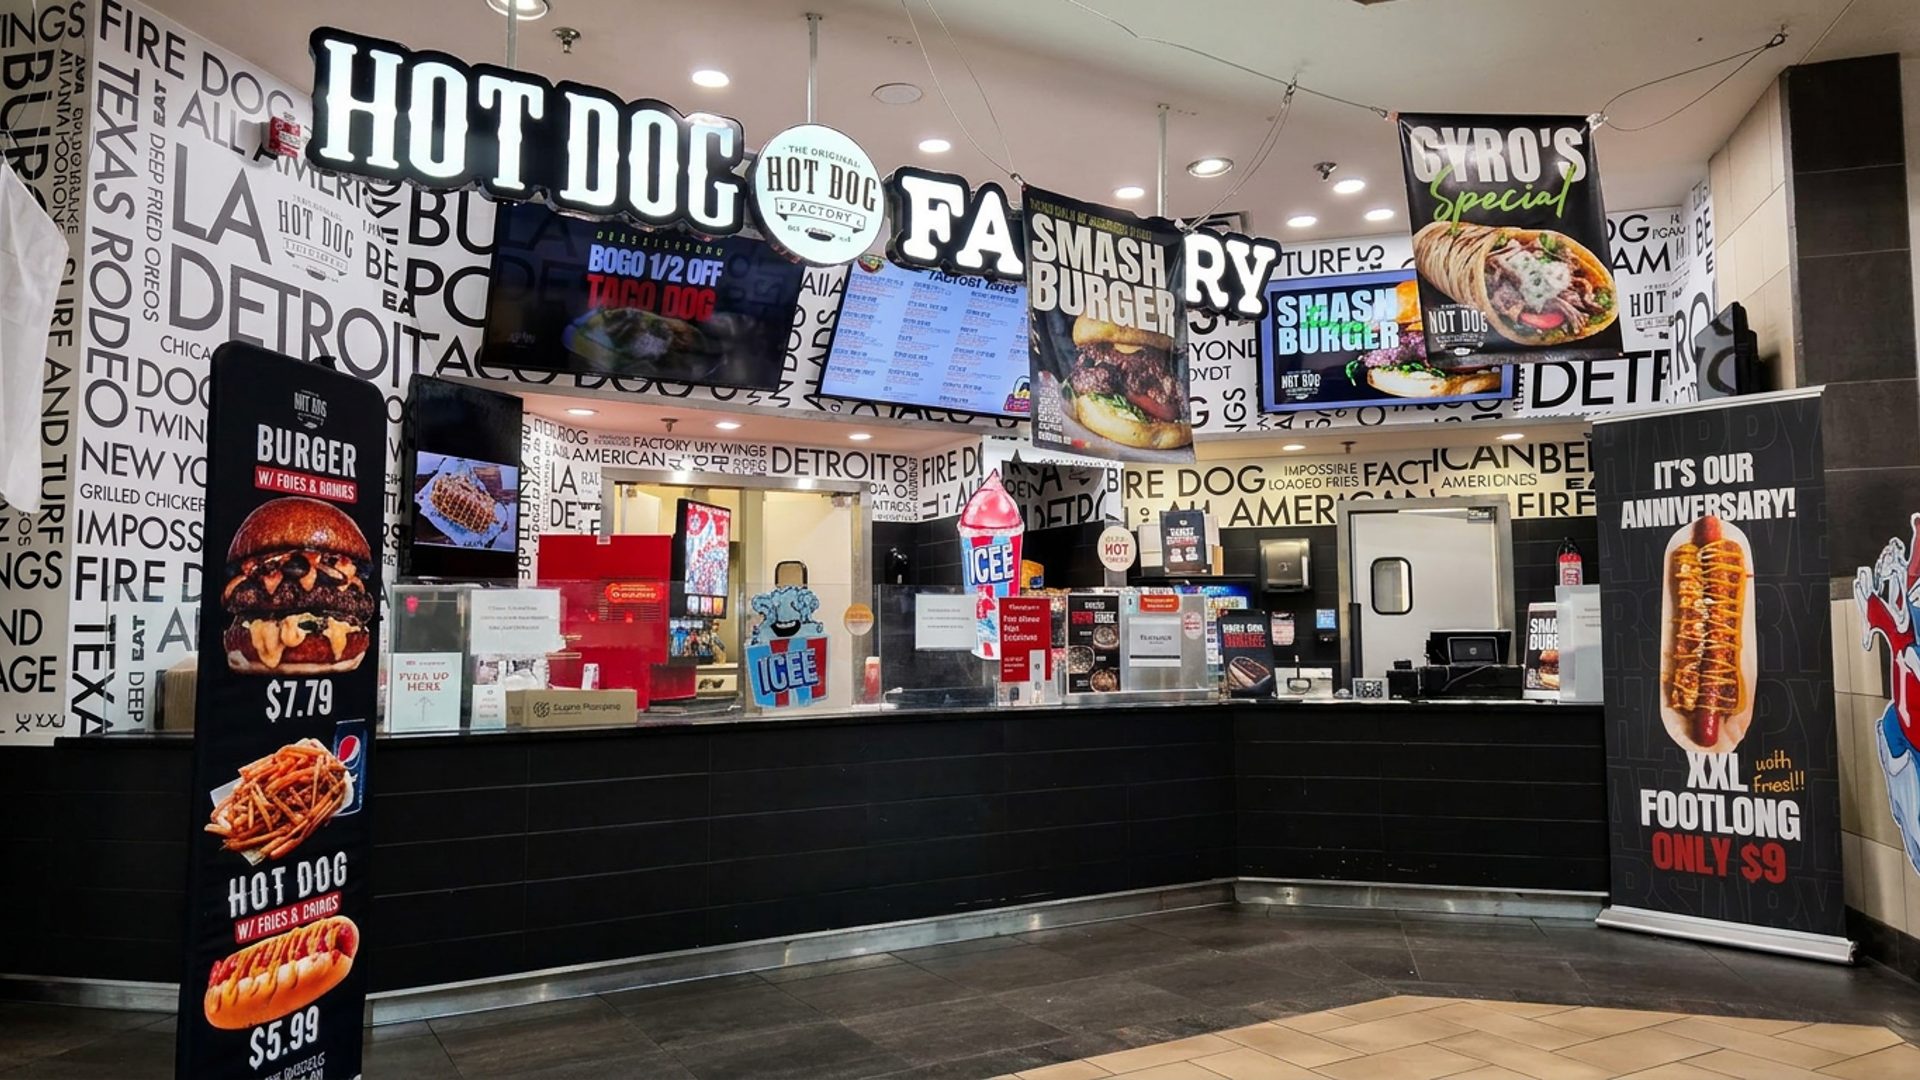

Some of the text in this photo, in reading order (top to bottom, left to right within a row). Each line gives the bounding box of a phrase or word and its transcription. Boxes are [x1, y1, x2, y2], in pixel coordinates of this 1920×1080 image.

[0, 1, 86, 48] INGS
[99, 1, 187, 80] FIRE
[1, 50, 54, 216] BUR
[177, 89, 245, 156] ALL
[320, 38, 544, 191] HOT
[559, 91, 739, 228] DOG
[149, 132, 166, 186] DEEP
[789, 145, 808, 155] THE
[1410, 126, 1587, 183] GYRO'S
[766, 156, 818, 194] HOT
[146, 187, 164, 242] FRIED
[172, 142, 272, 266] LA
[278, 199, 313, 240] HOT
[1430, 163, 1578, 235] Special
[85, 61, 141, 428] TEXAS RODEO
[588, 244, 646, 277] BOGO
[650, 253, 684, 282] 1/2
[687, 258, 723, 286] OFF
[1032, 213, 1166, 288] SMASH
[1281, 247, 1351, 276] TURF
[143, 248, 162, 322] OREOS
[587, 274, 716, 322] TACO DOG
[1032, 261, 1175, 338] BURGER
[1277, 288, 1397, 327] SMASH
[1630, 290, 1667, 317] HOT
[1278, 321, 1400, 355] BURGER
[42, 357, 72, 447] AND
[81, 437, 165, 480] NEW
[257, 423, 357, 478] BURGER
[572, 448, 665, 467] AMERICAN
[772, 446, 891, 480] DETROIT
[923, 450, 957, 487] FIRE
[1654, 452, 1754, 490] IT'S OUR
[38, 454, 67, 544] TURF
[80, 483, 140, 505] GRILLED
[258, 470, 273, 486] W/
[309, 479, 317, 493] &
[551, 462, 578, 495] LA
[1178, 465, 1266, 497] DOG
[1326, 476, 1359, 487] FRIES
[1621, 487, 1796, 529] ANNIVERSARY!
[75, 556, 166, 602] FIRE
[969, 544, 1014, 584] ICEE
[757, 648, 820, 695] ICEE
[265, 679, 333, 723] $7.79
[1686, 752, 1748, 792] XXL
[1640, 789, 1800, 841] FOOTLONG
[1652, 832, 1786, 884] ONLY $9
[228, 851, 348, 918] HOT DOG
[237, 919, 255, 940] W/
[258, 910, 287, 934] FRIES
[291, 907, 298, 924] &
[249, 1005, 319, 1071] $5.99
